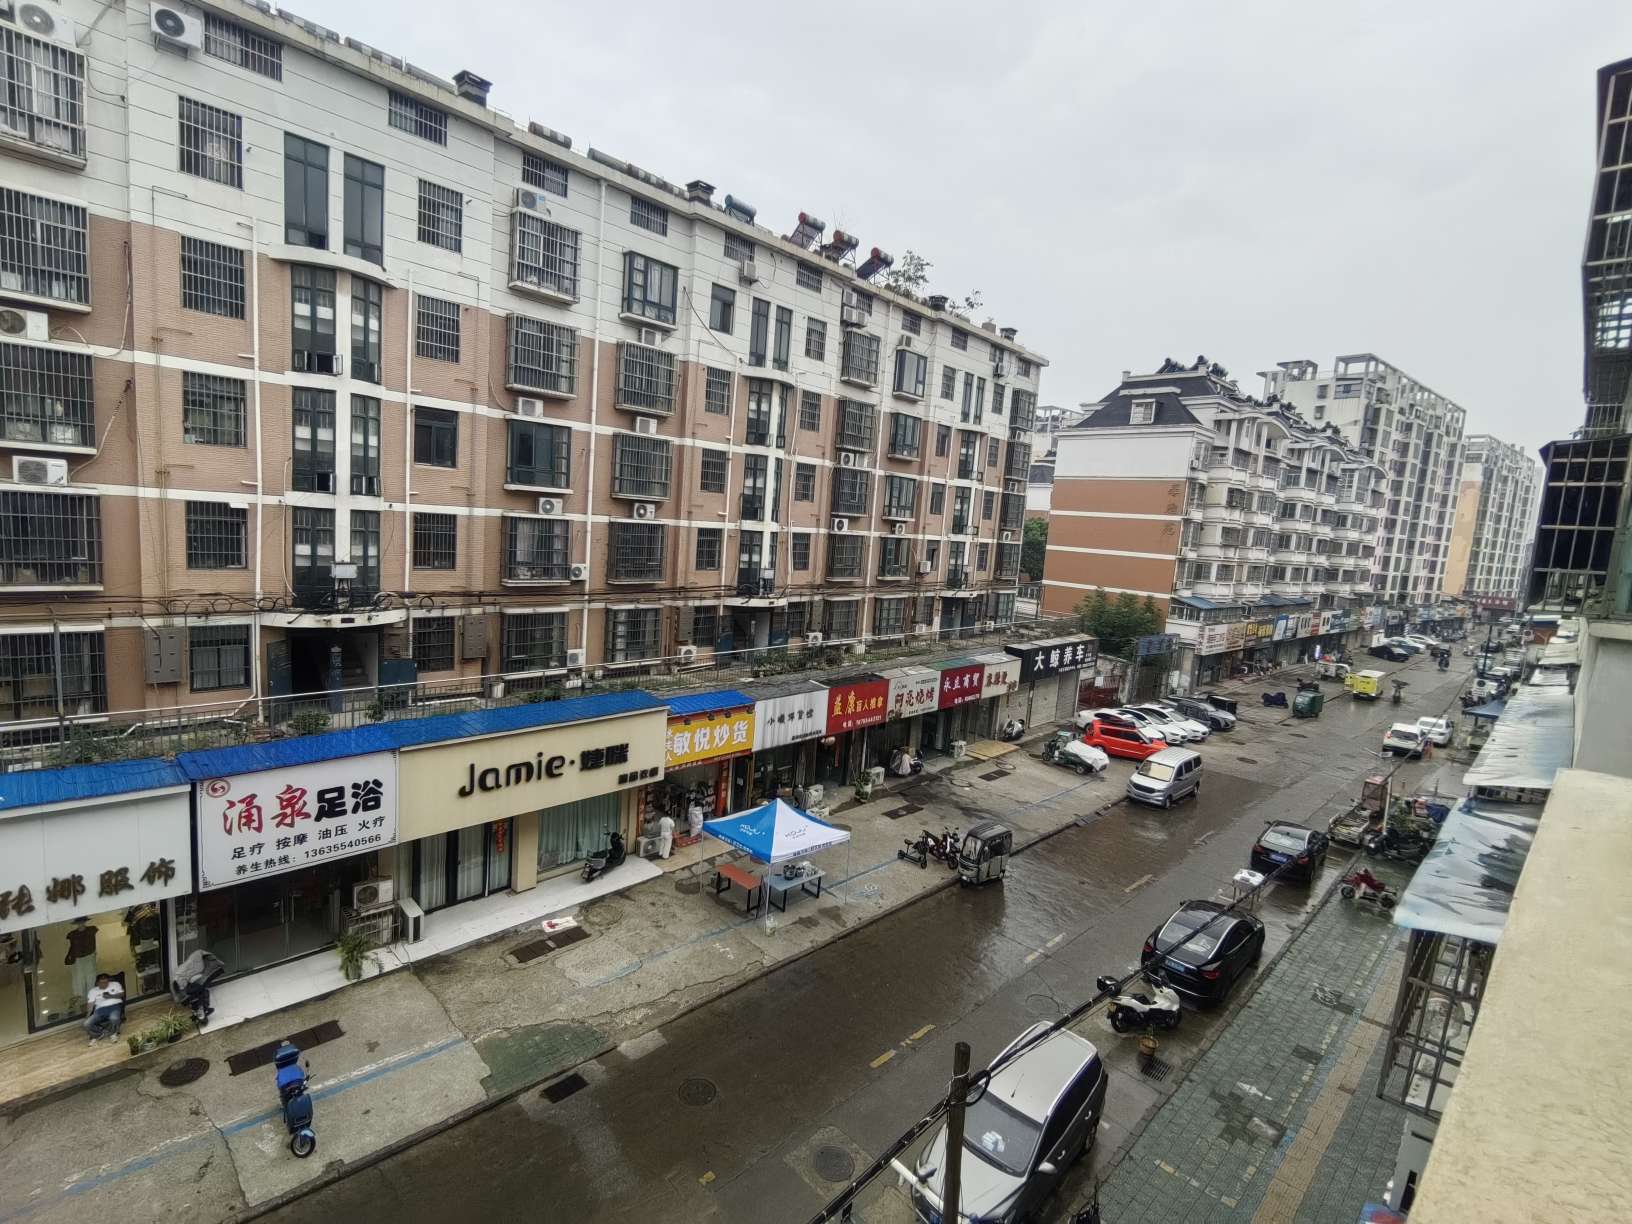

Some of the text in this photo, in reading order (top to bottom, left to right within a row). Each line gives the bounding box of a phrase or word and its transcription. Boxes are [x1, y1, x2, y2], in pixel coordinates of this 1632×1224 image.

[673, 720, 750, 757] 敏悦炒货
[222, 778, 384, 836] 涌泉足浴
[231, 815, 386, 861] 足疗 按摩 油压 火疗
[235, 833, 382, 876] 养生热线： 13635540566
